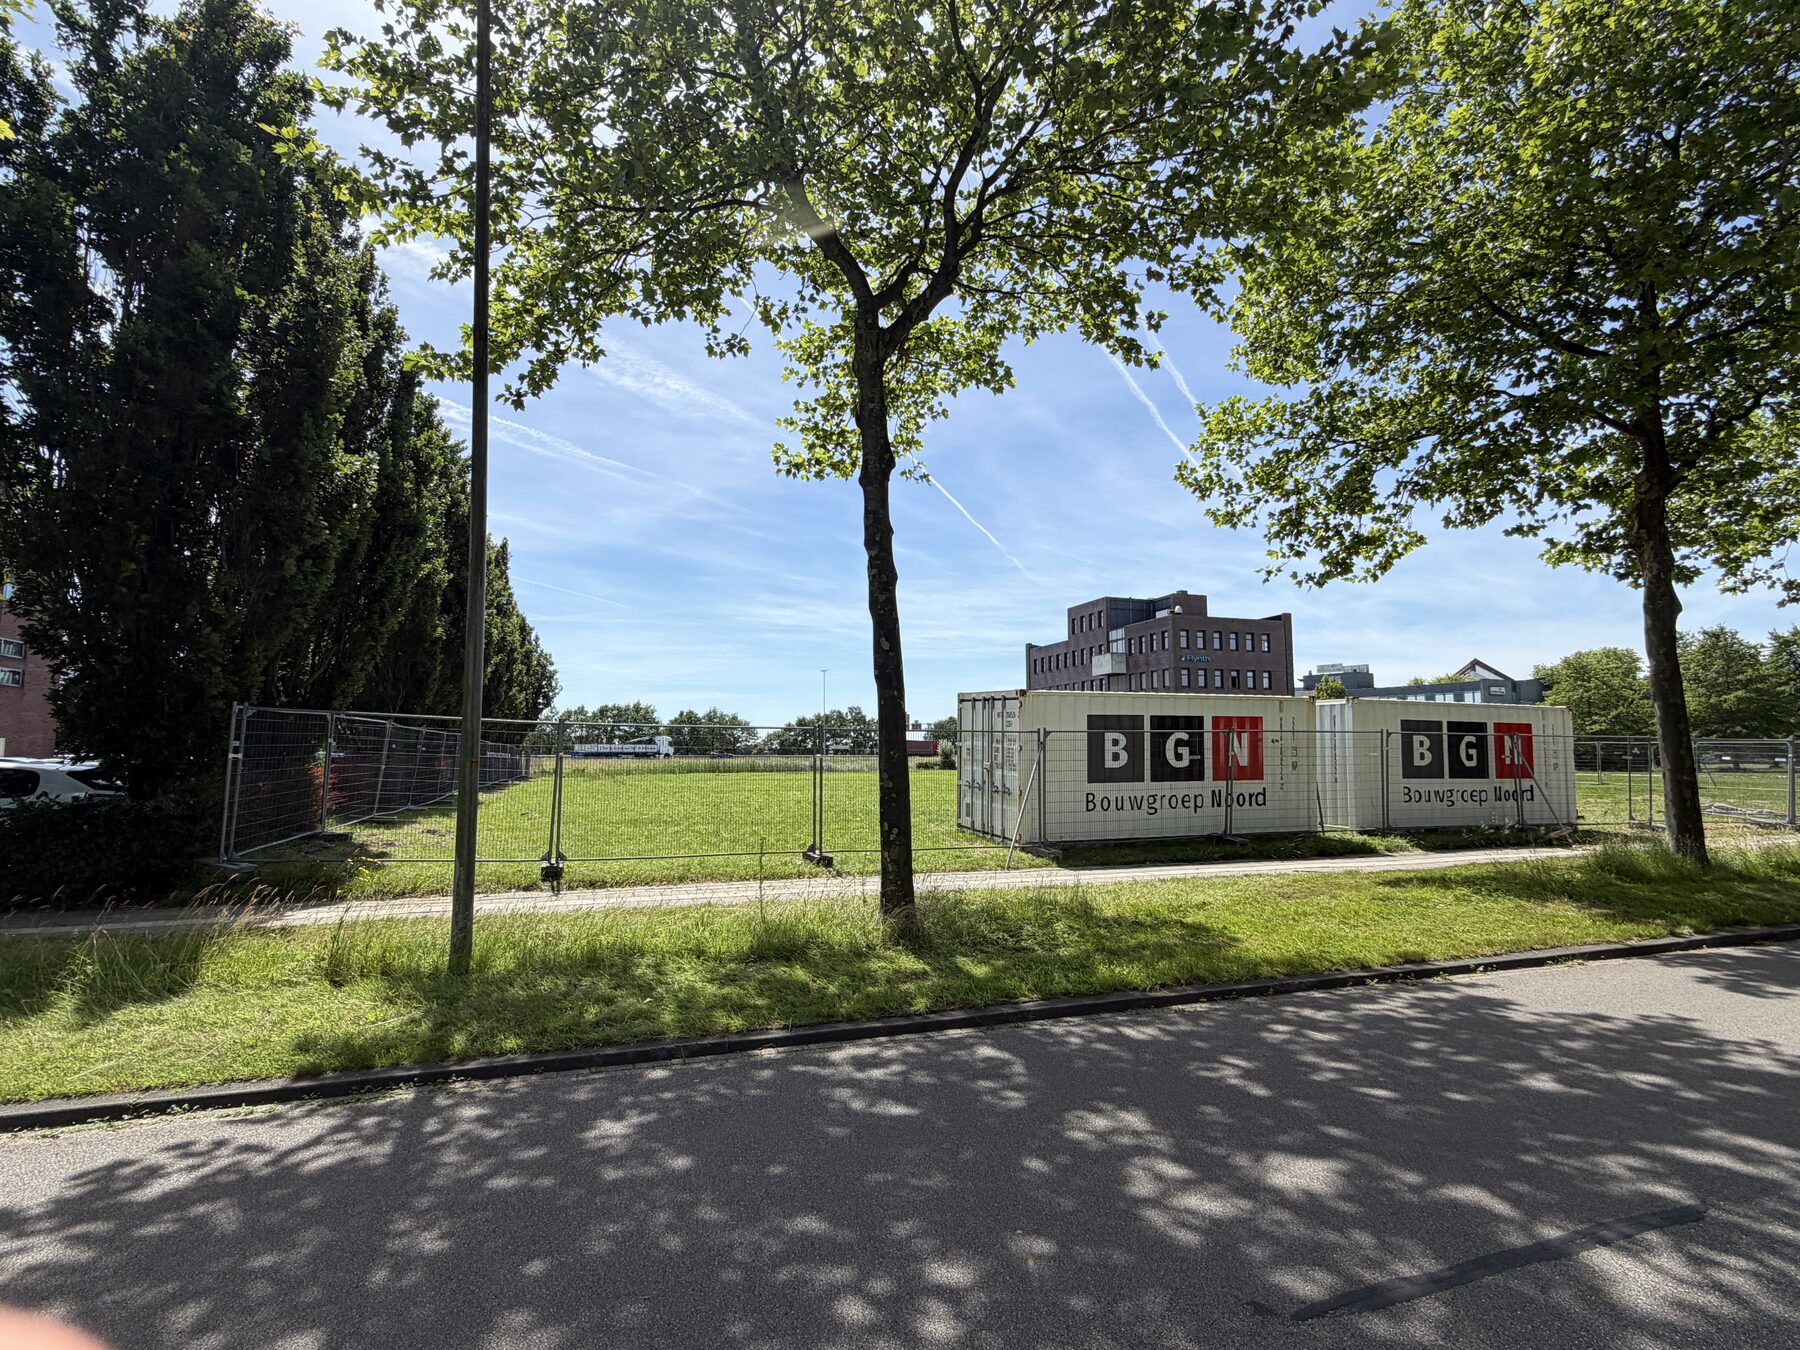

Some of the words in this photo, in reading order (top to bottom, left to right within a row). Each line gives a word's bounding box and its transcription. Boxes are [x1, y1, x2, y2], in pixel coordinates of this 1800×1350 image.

[1186, 654, 1211, 663] Flynth
[1085, 793, 1205, 816] Bouwgroep
[1211, 786, 1267, 808] Noord
[1403, 786, 1488, 808] Bouwgroep
